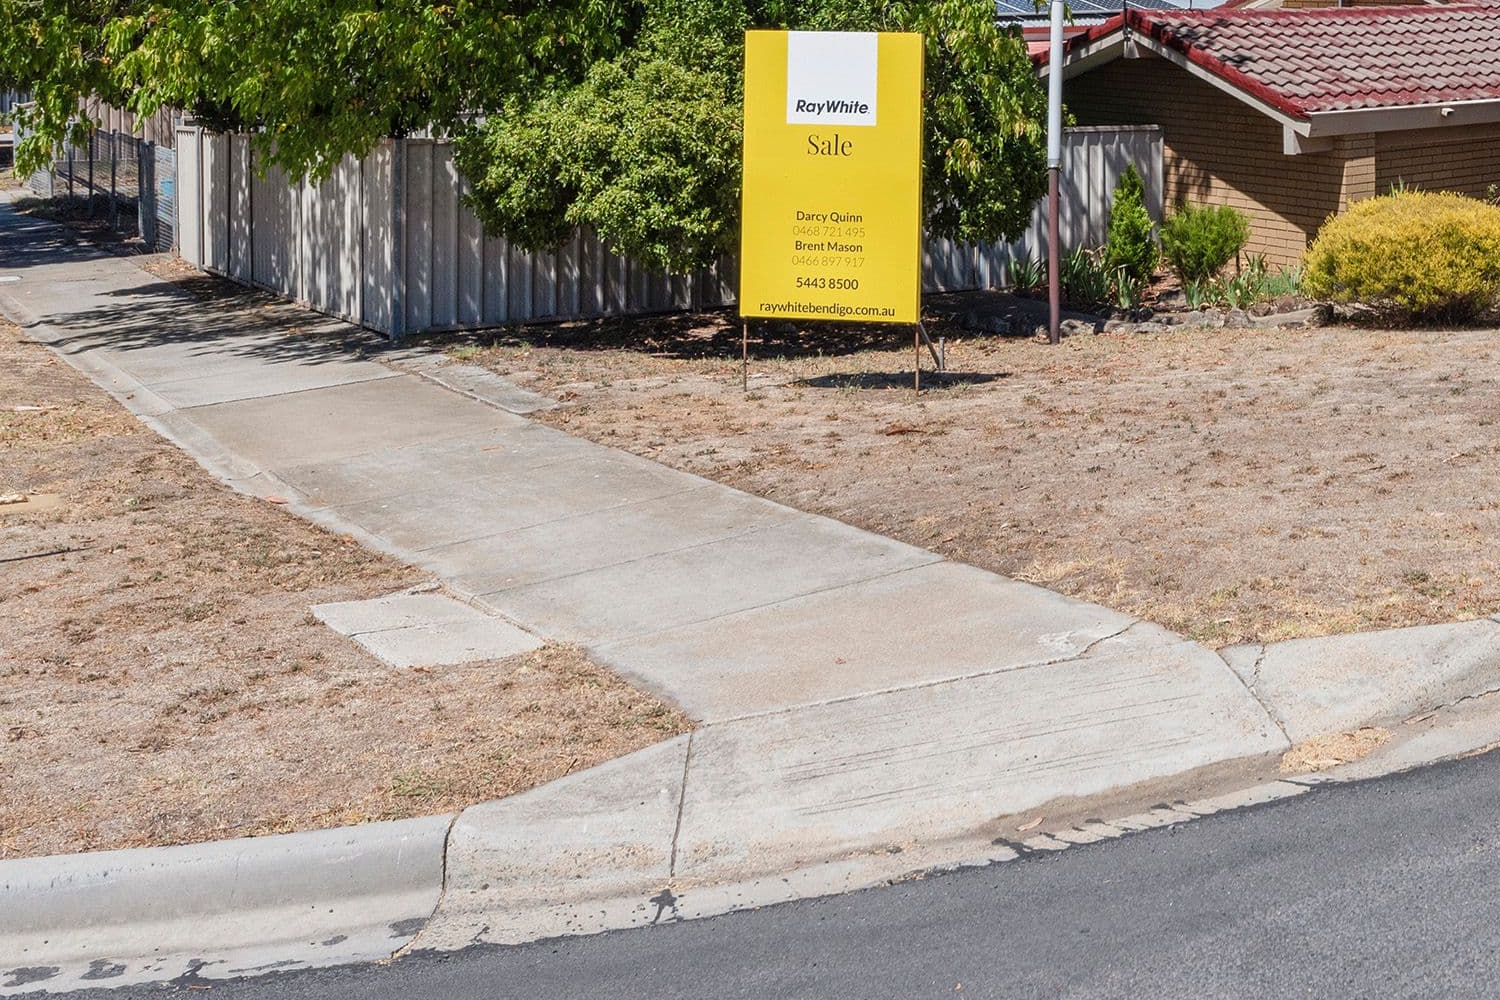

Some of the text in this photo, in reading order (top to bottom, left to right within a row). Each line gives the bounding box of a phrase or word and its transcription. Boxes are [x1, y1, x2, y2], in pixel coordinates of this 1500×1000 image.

[807, 133, 853, 157] Sale
[796, 211, 863, 223] Darcy Quinn
[793, 225, 866, 238] 0468 721 495
[795, 241, 863, 253] Brent Mason
[791, 255, 865, 269] 0466 897 917
[796, 277, 859, 290] 5443 8500
[759, 302, 895, 317] raywhitebendigo.com.au
